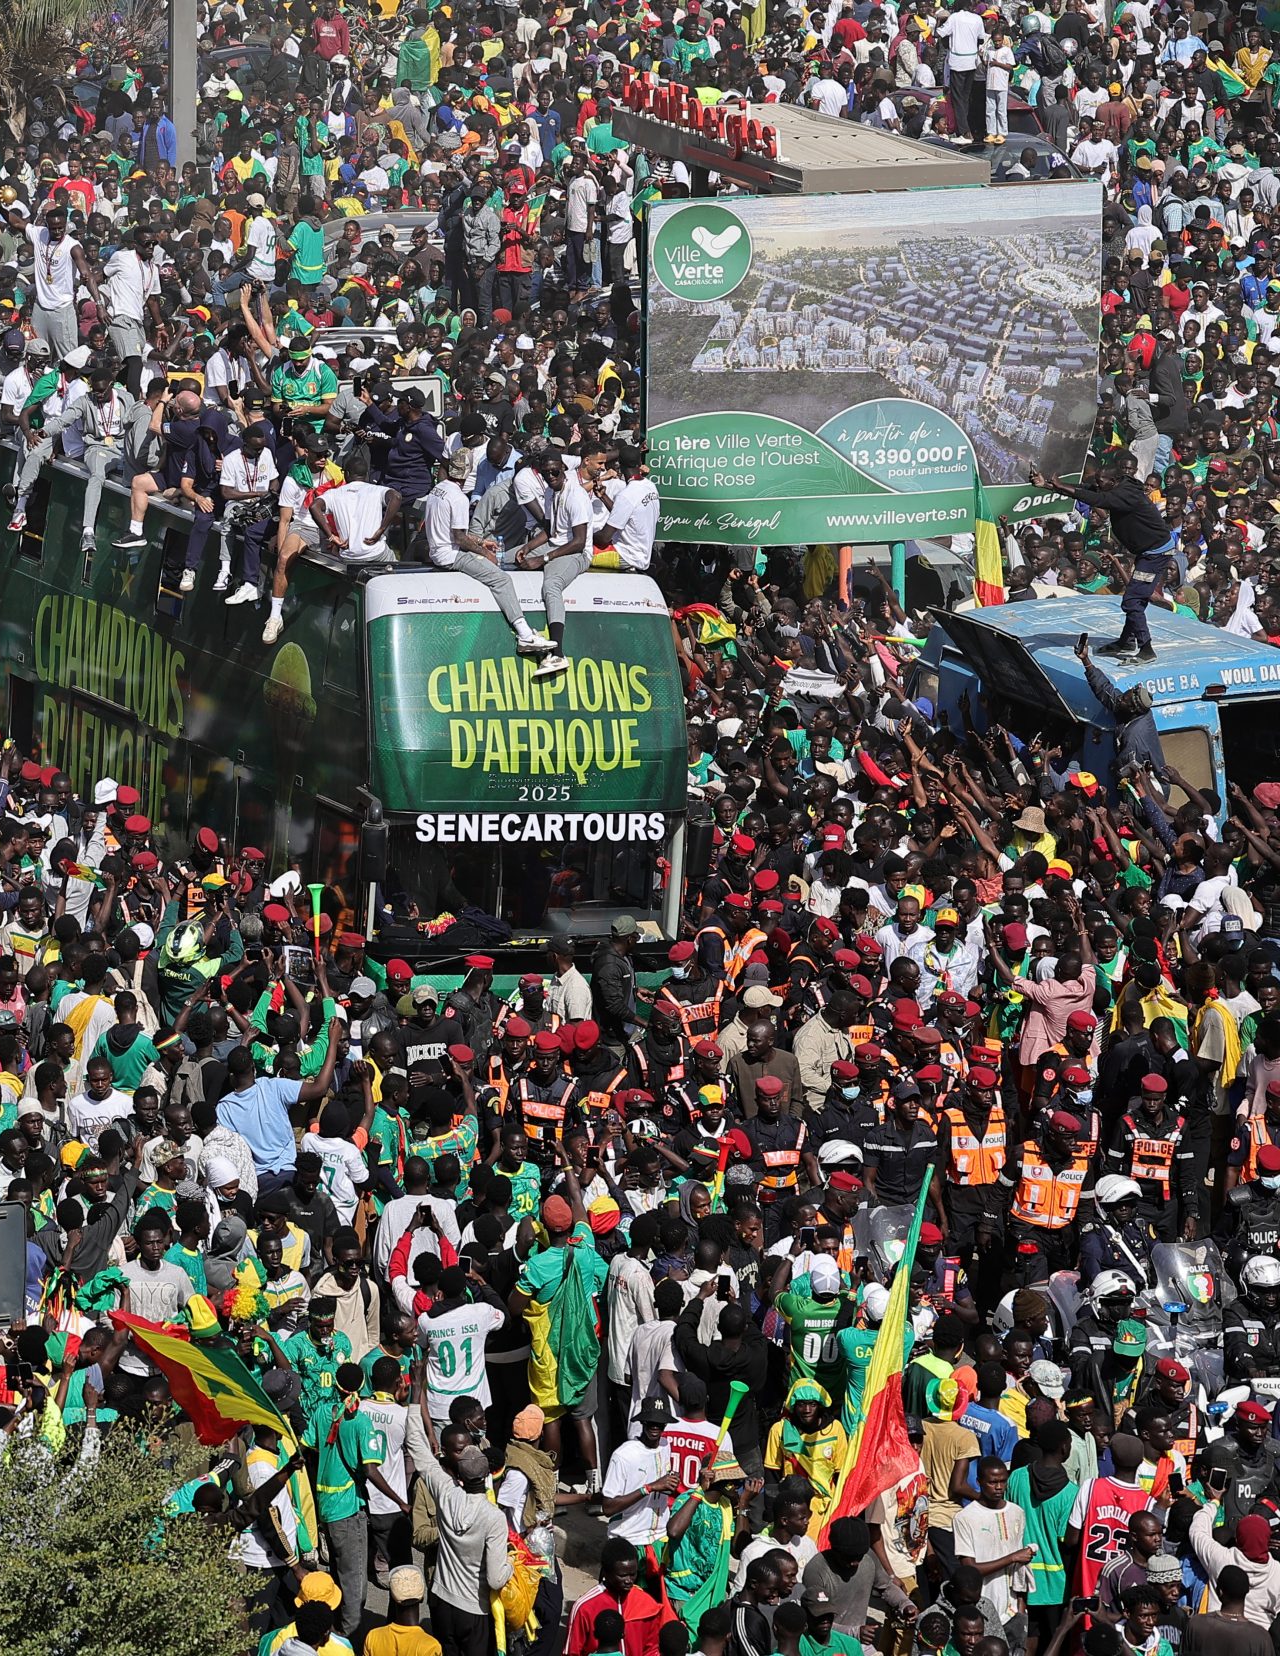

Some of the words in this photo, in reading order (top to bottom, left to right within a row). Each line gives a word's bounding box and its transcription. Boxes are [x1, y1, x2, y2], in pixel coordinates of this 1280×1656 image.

[619, 63, 778, 161] TotalEnergies
[664, 245, 701, 263] Ville
[670, 263, 724, 279] Verte
[651, 437, 670, 452] La
[675, 436, 711, 451] 1ère
[715, 434, 750, 449] Ville
[755, 434, 802, 448] Verte
[851, 421, 905, 448] partir
[910, 421, 932, 442] de
[733, 453, 756, 467] de
[850, 446, 953, 468] 13,390,000
[957, 445, 968, 460] F
[649, 473, 671, 488] au
[678, 474, 708, 488] Lac
[714, 472, 756, 487] Rose
[888, 466, 916, 479] pour
[919, 465, 932, 475] un
[934, 463, 968, 474] studio
[657, 513, 691, 532] oyau
[694, 512, 712, 528] du
[716, 511, 782, 539] Sénégal
[826, 507, 968, 527] www.villeverte.sn
[35, 594, 186, 738] CHAMPIONS
[427, 656, 653, 714] CHAMPIONS
[1178, 673, 1198, 690] BA
[1220, 669, 1256, 685] WOUL
[449, 717, 642, 785] D'AFRIQUE
[518, 786, 571, 802] 2025
[415, 812, 666, 842] SENECARTOURS
[684, 1002, 715, 1018] POLICE
[406, 1042, 448, 1067] DICKIES
[524, 1102, 563, 1117] POLICE
[985, 1136, 1004, 1144] POLIC
[1136, 1140, 1174, 1155] POLICE
[323, 1166, 336, 1190] 7
[1061, 1172, 1083, 1181] POLICE
[516, 1192, 534, 1213] 26
[1249, 1230, 1278, 1245] POLICE
[130, 1282, 176, 1306] NYC
[428, 1327, 456, 1339] PRINCE
[461, 1324, 479, 1335] ISSA
[438, 1336, 473, 1378] 01
[803, 1332, 839, 1364] 00
[320, 1371, 332, 1388] 10
[667, 1436, 705, 1452] PIOCHE
[669, 1452, 702, 1489] 10
[1085, 1523, 1132, 1563] 23
